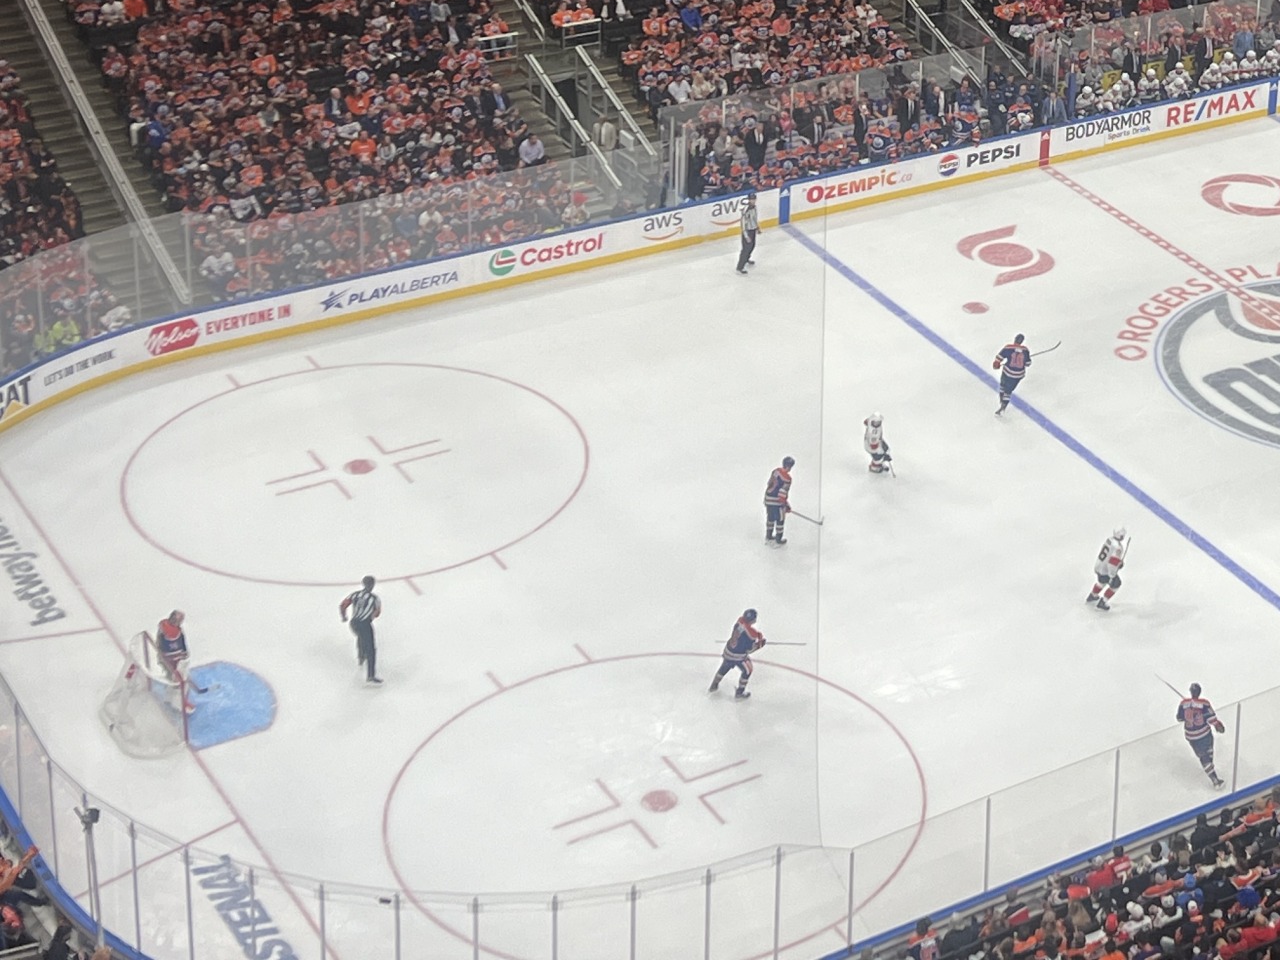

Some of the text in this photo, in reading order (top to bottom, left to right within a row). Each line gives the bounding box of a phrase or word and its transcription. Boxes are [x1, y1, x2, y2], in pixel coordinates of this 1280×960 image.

[1166, 89, 1257, 128] RE/MAX
[1065, 110, 1152, 142] BODYARMOR
[1108, 125, 1151, 141] Sports Drink
[939, 161, 959, 171] PEPSI
[966, 143, 1021, 168] PEPSI
[643, 211, 683, 232] aws
[711, 197, 748, 218] aws
[520, 232, 604, 267] Castrol
[347, 271, 459, 307] PLAYALBERTA
[206, 304, 292, 336] EVERYONE IN
[1122, 277, 1215, 349] ROGERS
[0, 518, 66, 626] betway.n
